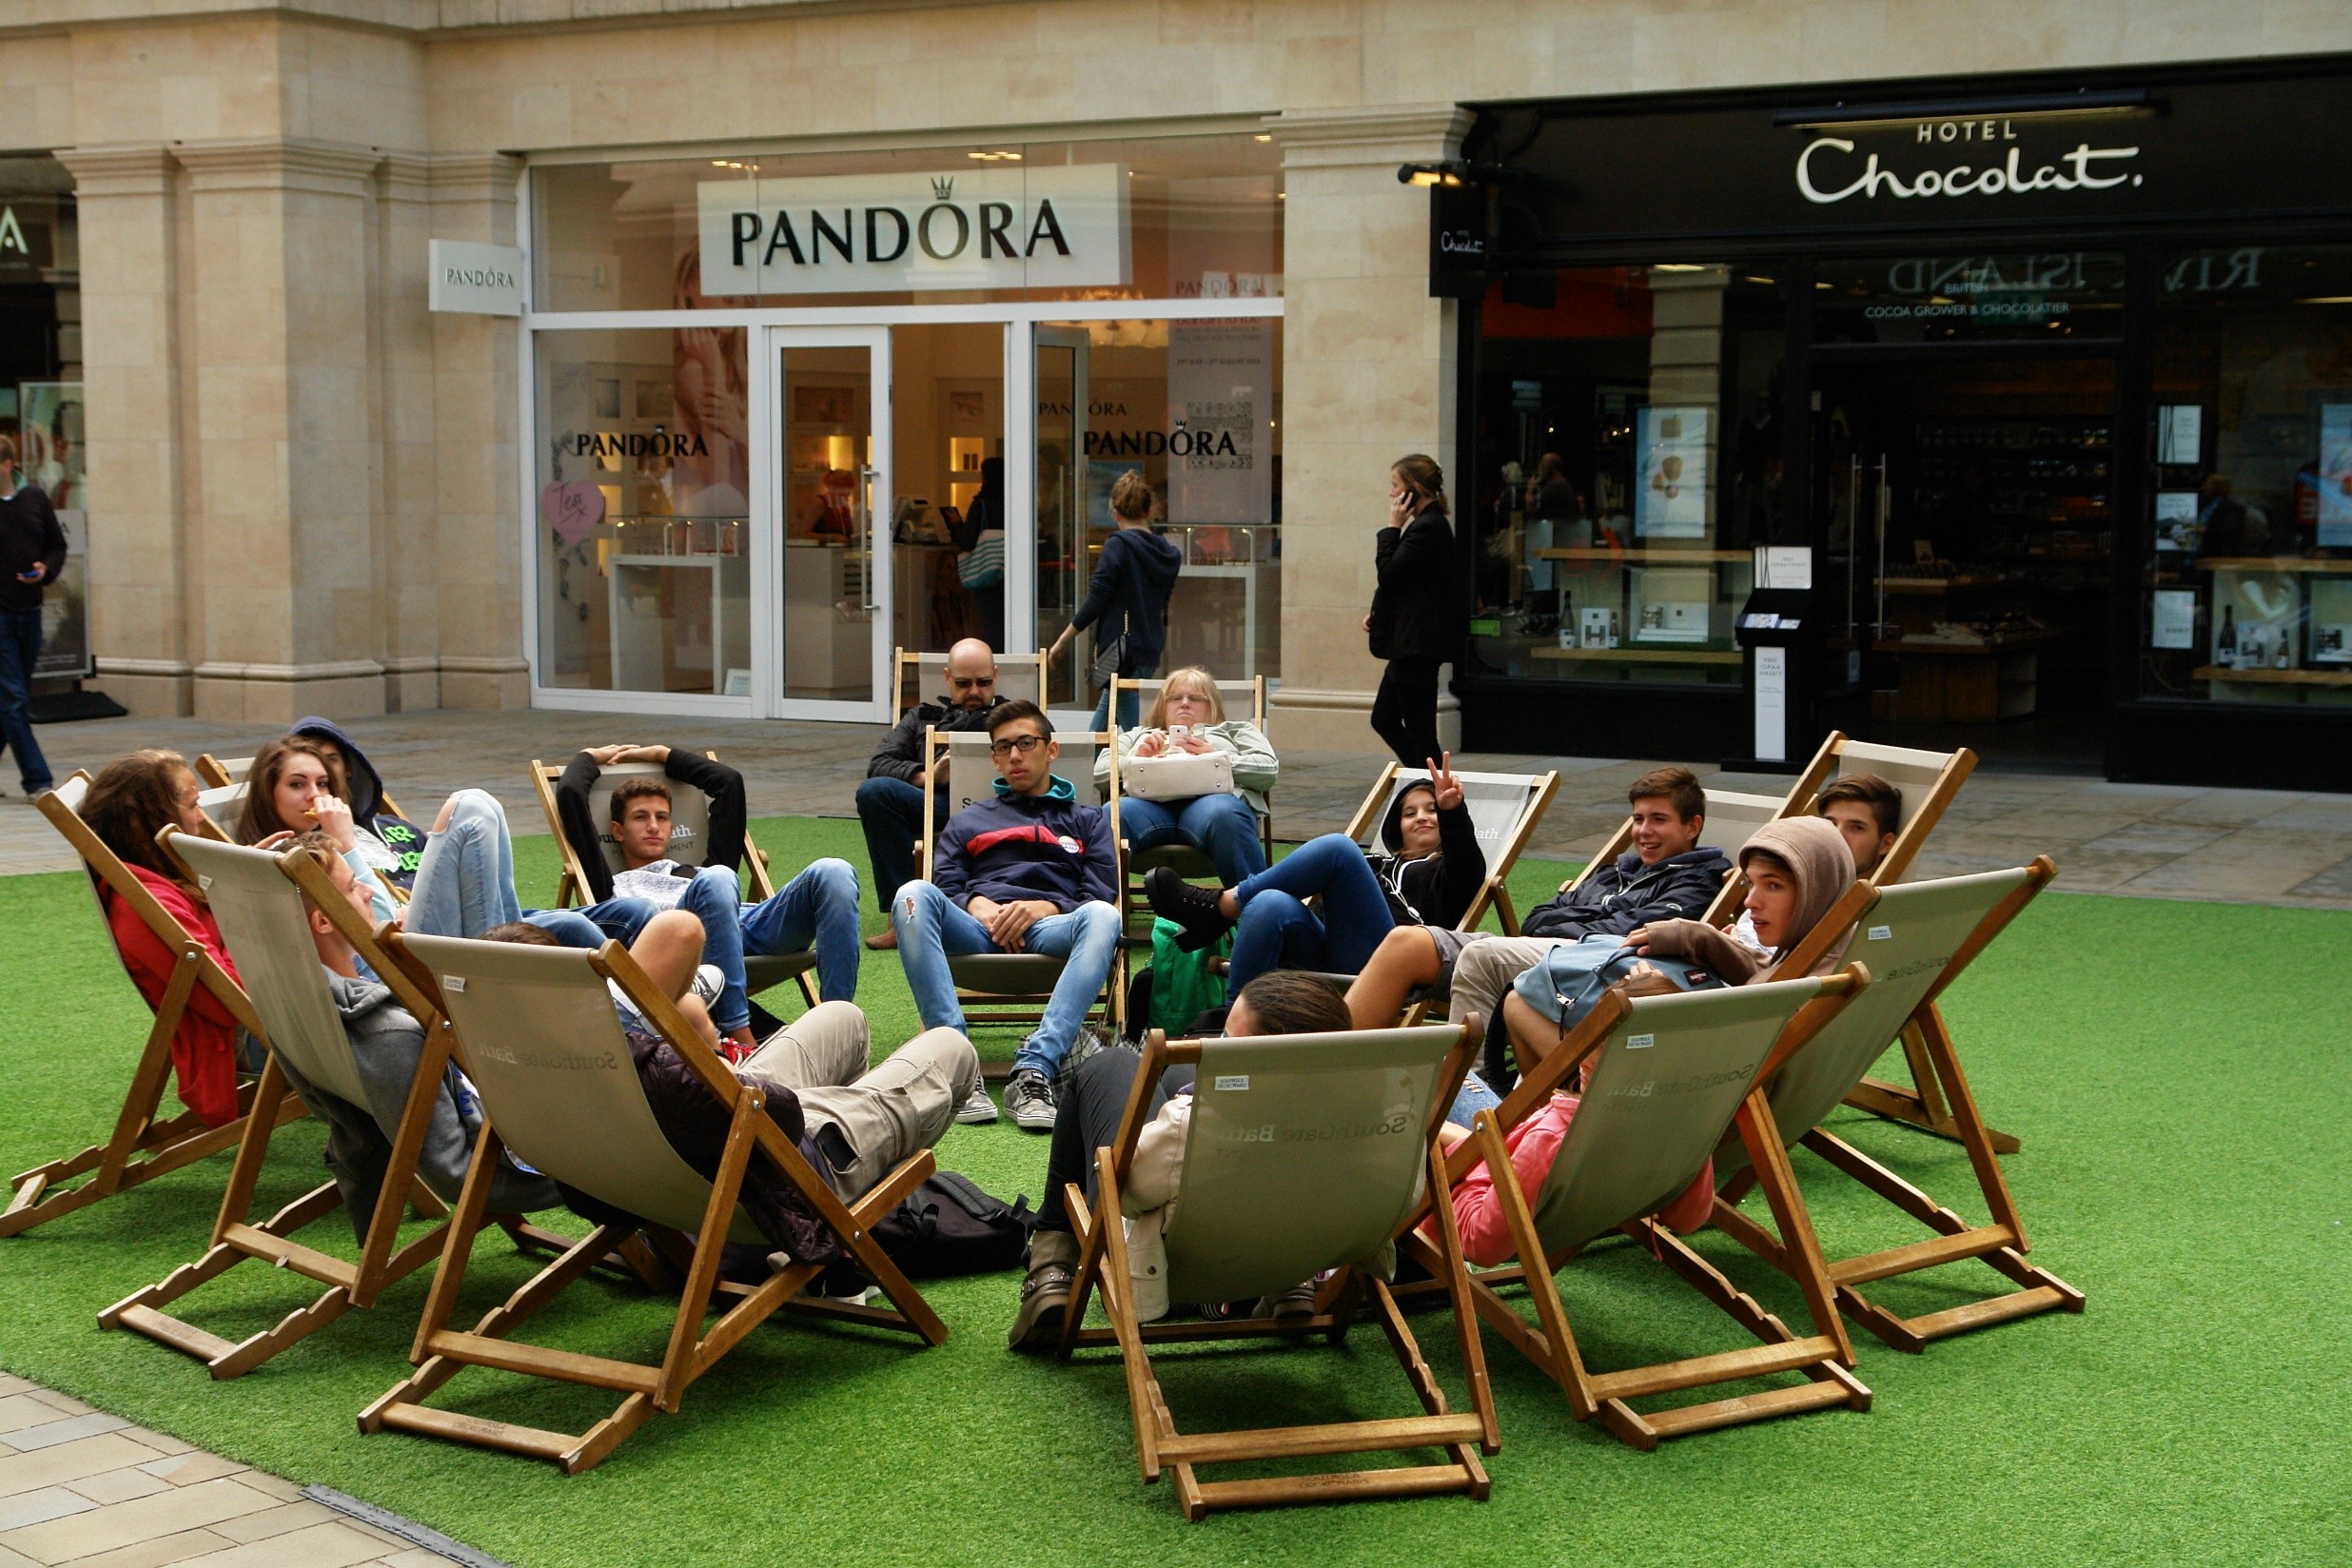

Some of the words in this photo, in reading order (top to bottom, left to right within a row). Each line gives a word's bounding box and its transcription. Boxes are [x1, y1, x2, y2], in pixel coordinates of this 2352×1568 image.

[1916, 120, 2018, 143] HOTEL
[732, 197, 1071, 266] PANDORA
[445, 267, 515, 287] PANDORA
[1864, 305, 1911, 319] COCOA
[1913, 304, 1968, 317] GROWER
[1982, 302, 2070, 316] CHOCOLATIER
[577, 434, 709, 457] PANDORA
[1083, 430, 1237, 456] PANDORA
[671, 824, 692, 838] ath
